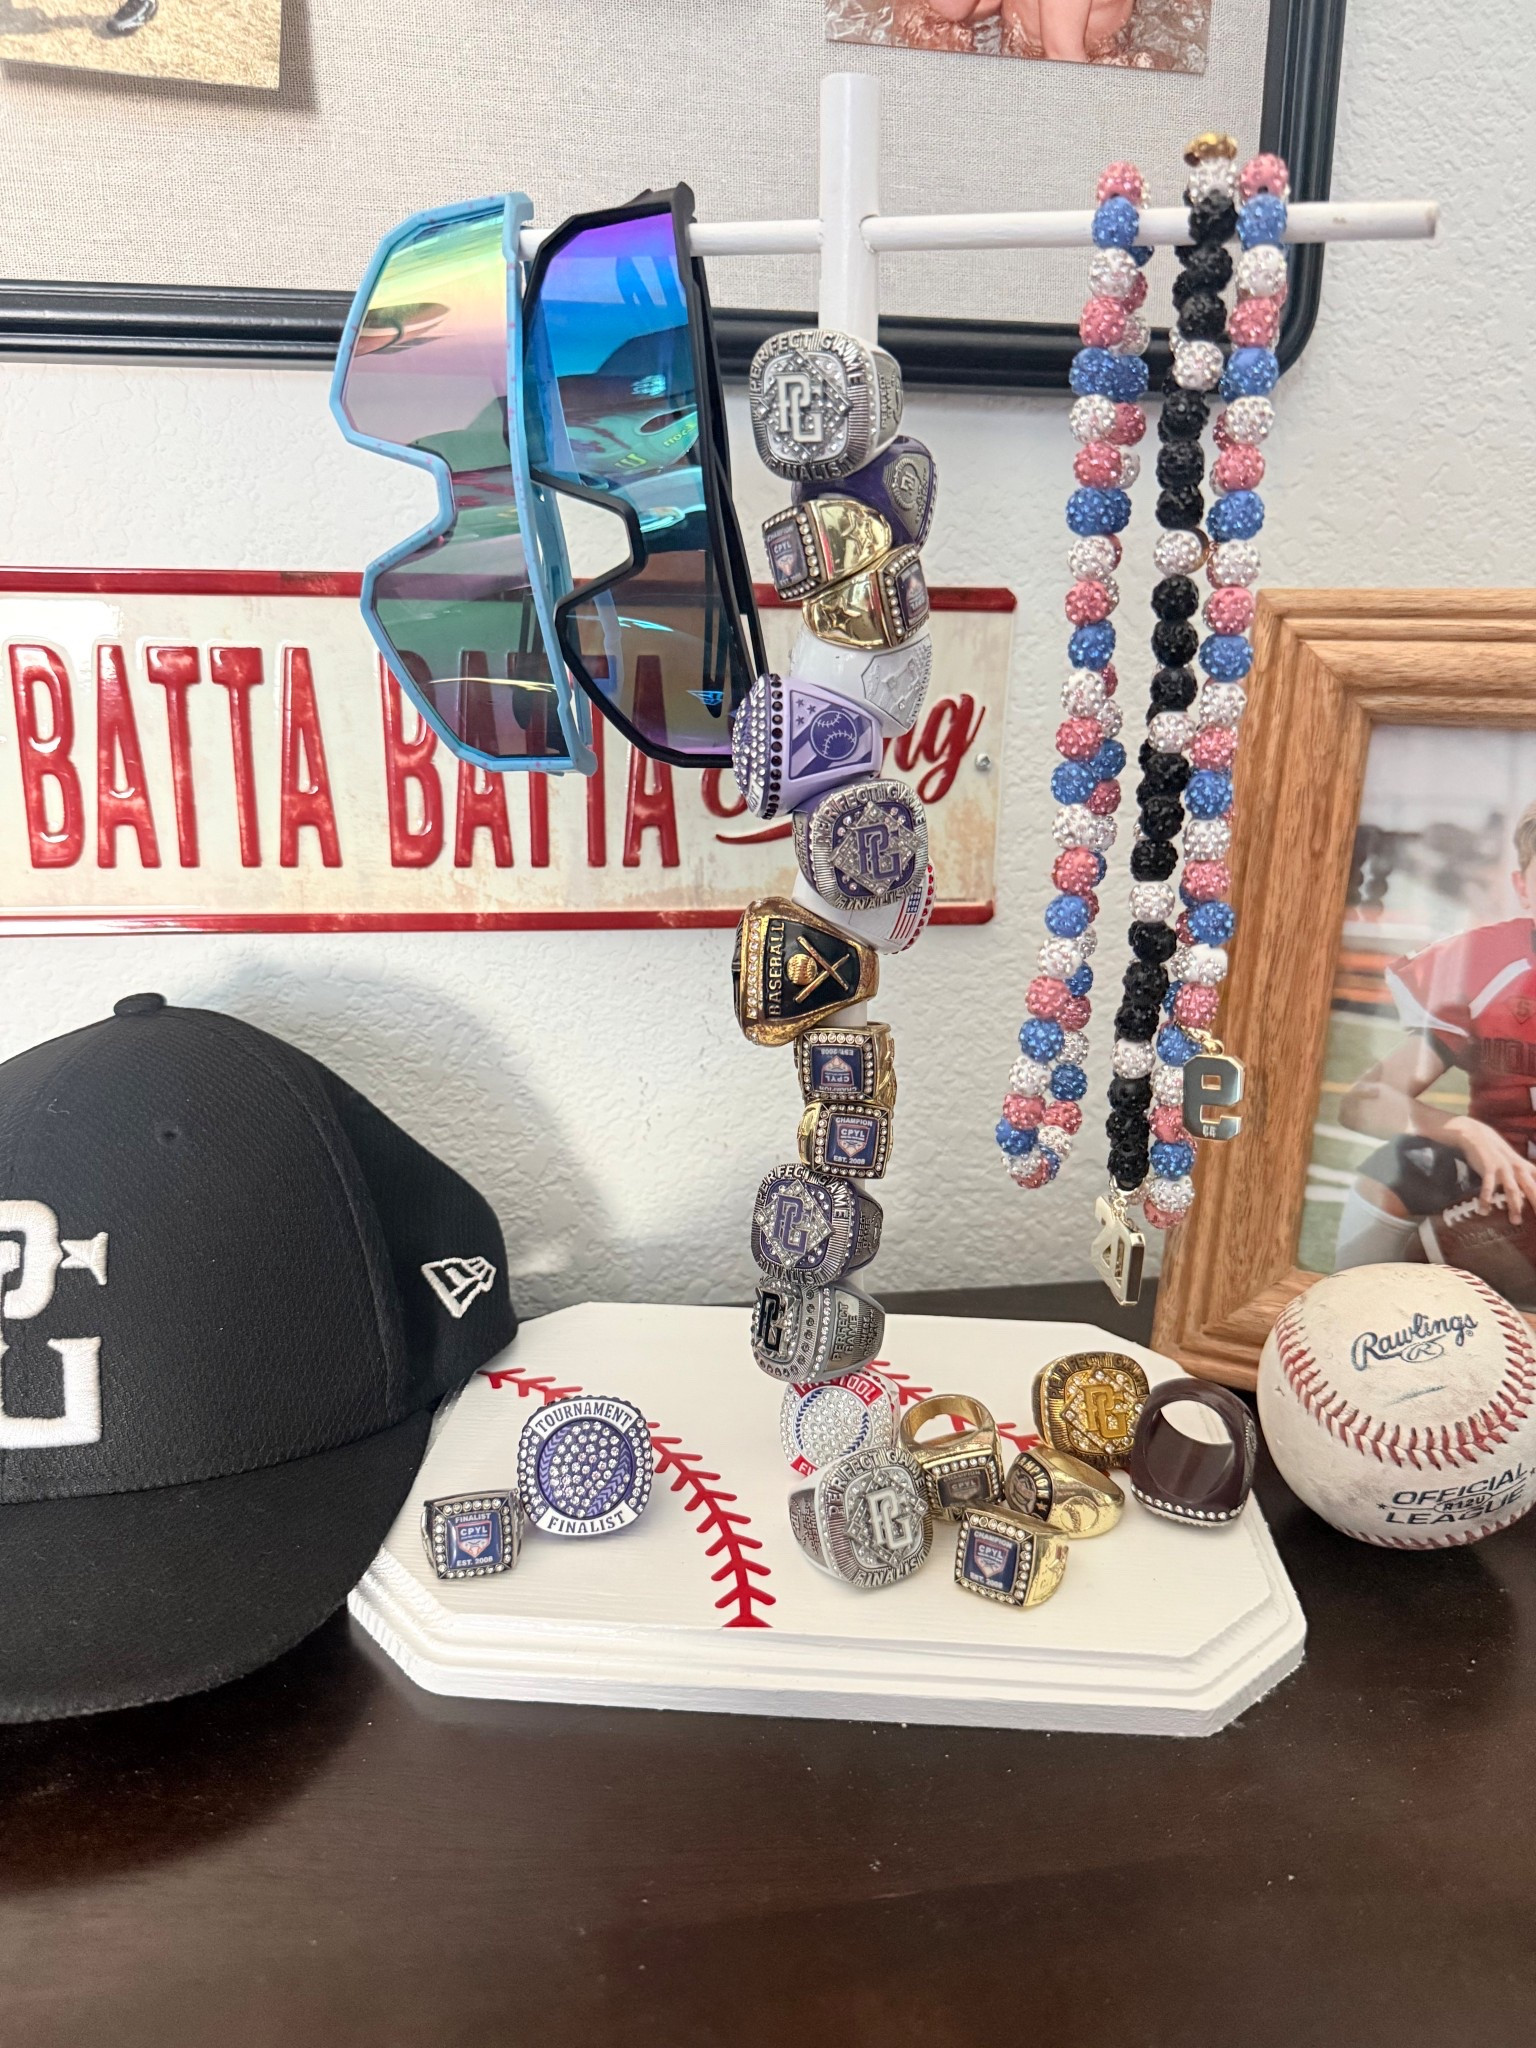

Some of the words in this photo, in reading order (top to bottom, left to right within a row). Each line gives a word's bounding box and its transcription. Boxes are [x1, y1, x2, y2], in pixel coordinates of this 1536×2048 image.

[750, 332, 814, 392] PERFECT
[820, 333, 867, 385] GAME
[766, 454, 857, 481] FINALIST
[773, 541, 792, 555] CPYL
[8, 644, 343, 868] BATTA
[379, 648, 681, 868] BATTA
[813, 782, 882, 843] PERFECT
[886, 784, 925, 826] GAME
[768, 921, 785, 1016] BASEBALL
[824, 1074, 850, 1083] CPYL
[835, 1116, 873, 1127] CHAMPION
[841, 1128, 865, 1138] CPYL
[833, 1155, 848, 1163] EST.
[760, 1164, 809, 1205] PERFECT
[816, 1173, 849, 1219] GAME
[759, 1253, 824, 1285] FINALIST
[832, 1301, 849, 1361] PERFECT
[844, 1314, 858, 1355] GAME
[1351, 1313, 1478, 1371] Rawlings
[839, 1375, 876, 1402] TOOL
[1048, 1354, 1105, 1397] PERFECT
[535, 1401, 633, 1434] TOURNAMENT
[828, 1452, 881, 1517] PERFECT
[886, 1449, 926, 1489] GAME
[951, 1479, 977, 1490] CPYL
[1391, 1462, 1529, 1506] OFFICIAL
[455, 1512, 491, 1524] FINALIST
[1385, 1484, 1526, 1525] LEAGUE
[460, 1525, 488, 1536] CPYL
[546, 1509, 626, 1534] FINALIST
[973, 1530, 1013, 1550] CHAMPION
[978, 1544, 1004, 1560] CPYL
[456, 1558, 473, 1567] EST.
[853, 1552, 927, 1588] FINALIST
